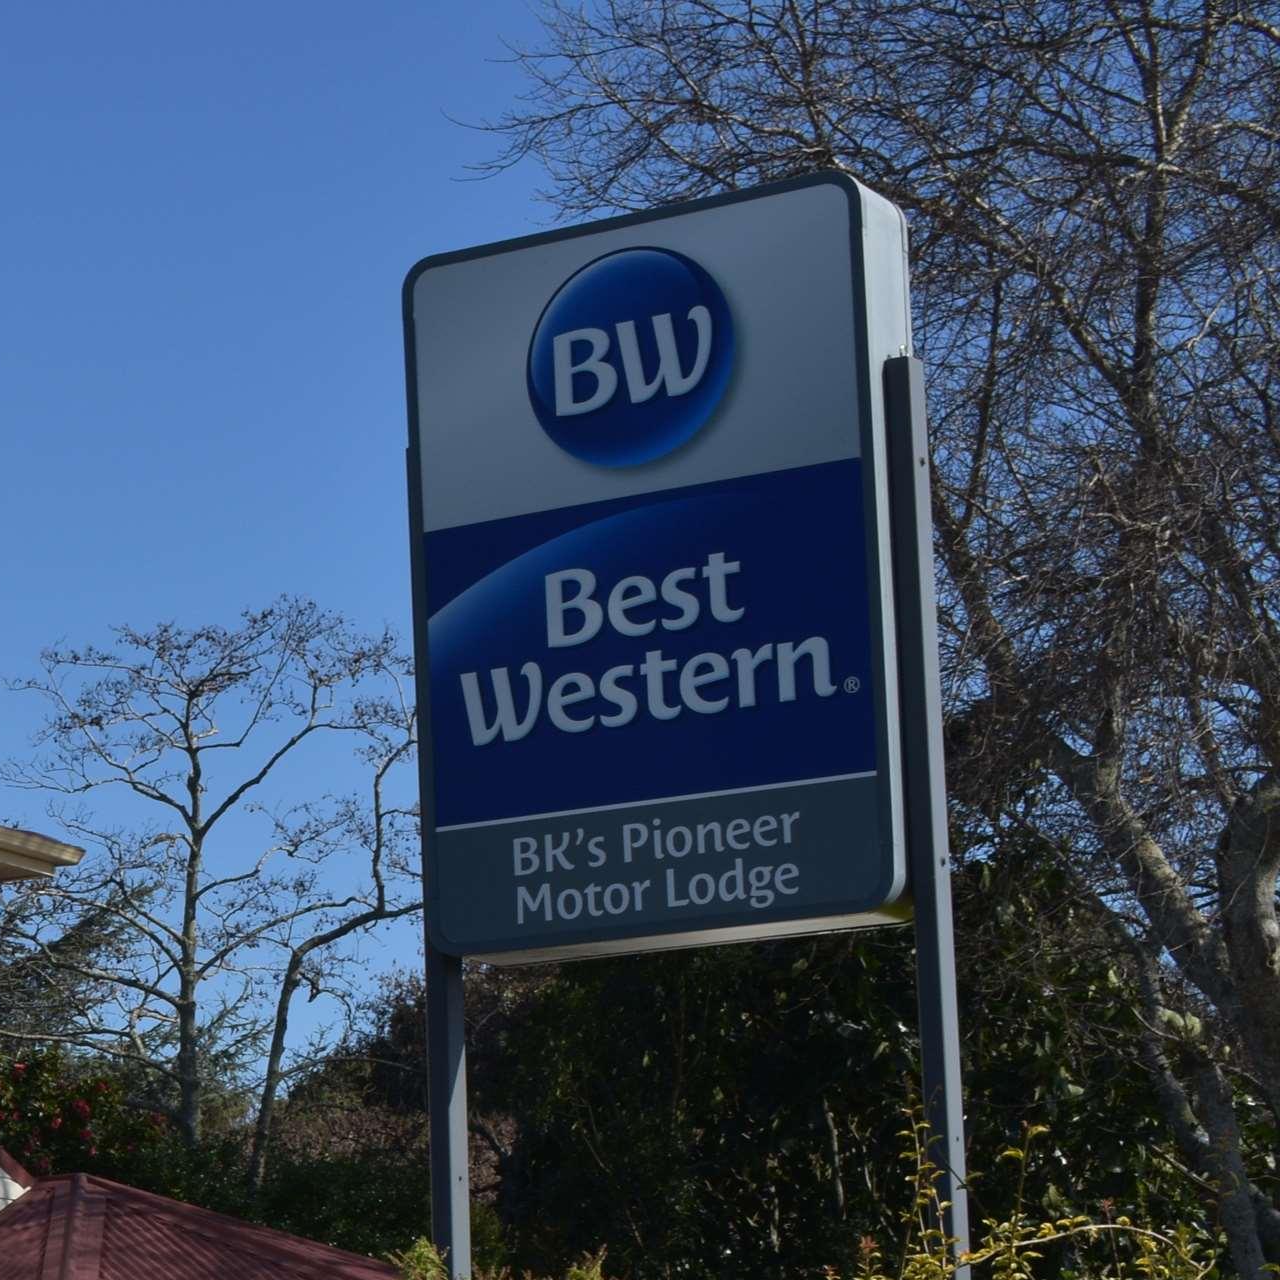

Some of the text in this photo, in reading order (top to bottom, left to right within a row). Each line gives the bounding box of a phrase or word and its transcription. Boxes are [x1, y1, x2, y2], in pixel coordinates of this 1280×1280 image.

[552, 305, 712, 418] BW
[544, 552, 745, 649] Best
[459, 635, 839, 747] Western
[512, 811, 801, 877] BK's Pioneer
[516, 858, 800, 925] Motor Lodge
